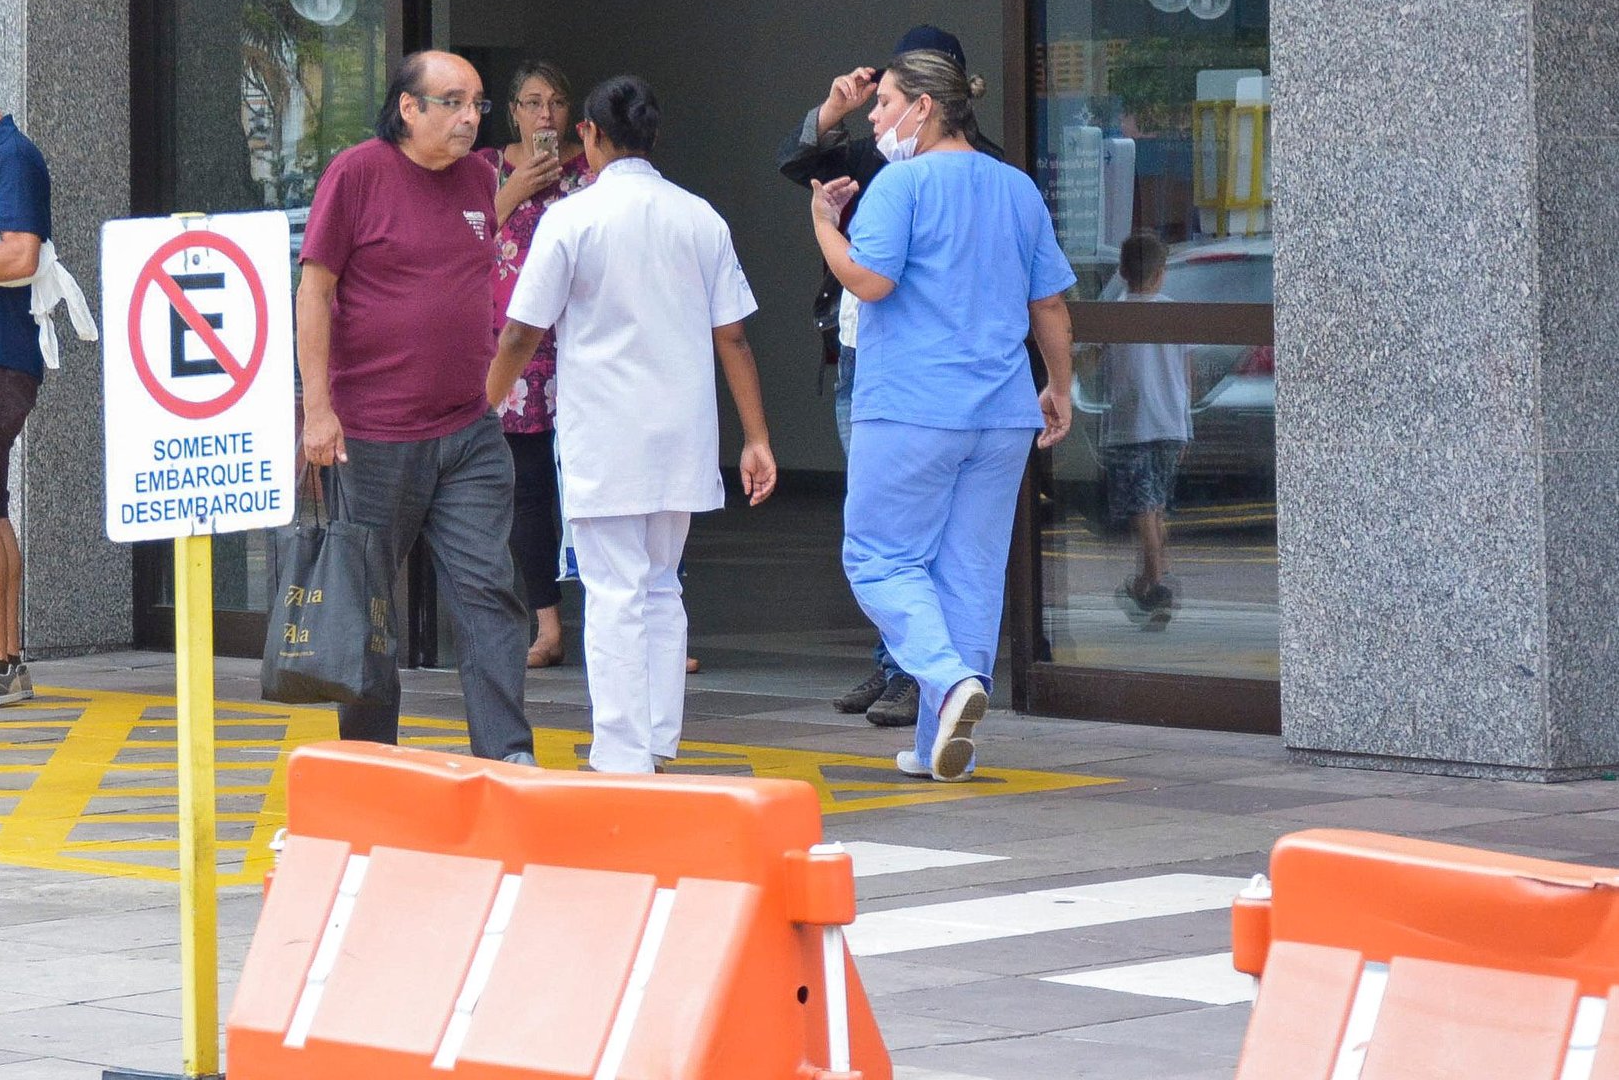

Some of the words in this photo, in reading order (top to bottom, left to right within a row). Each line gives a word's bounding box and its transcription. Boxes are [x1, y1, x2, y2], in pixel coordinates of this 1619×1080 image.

[153, 432, 254, 461] SOMENTE
[135, 461, 254, 493] EMBARQUE
[260, 460, 272, 482] E
[121, 489, 281, 524] DESEMBARQUE
